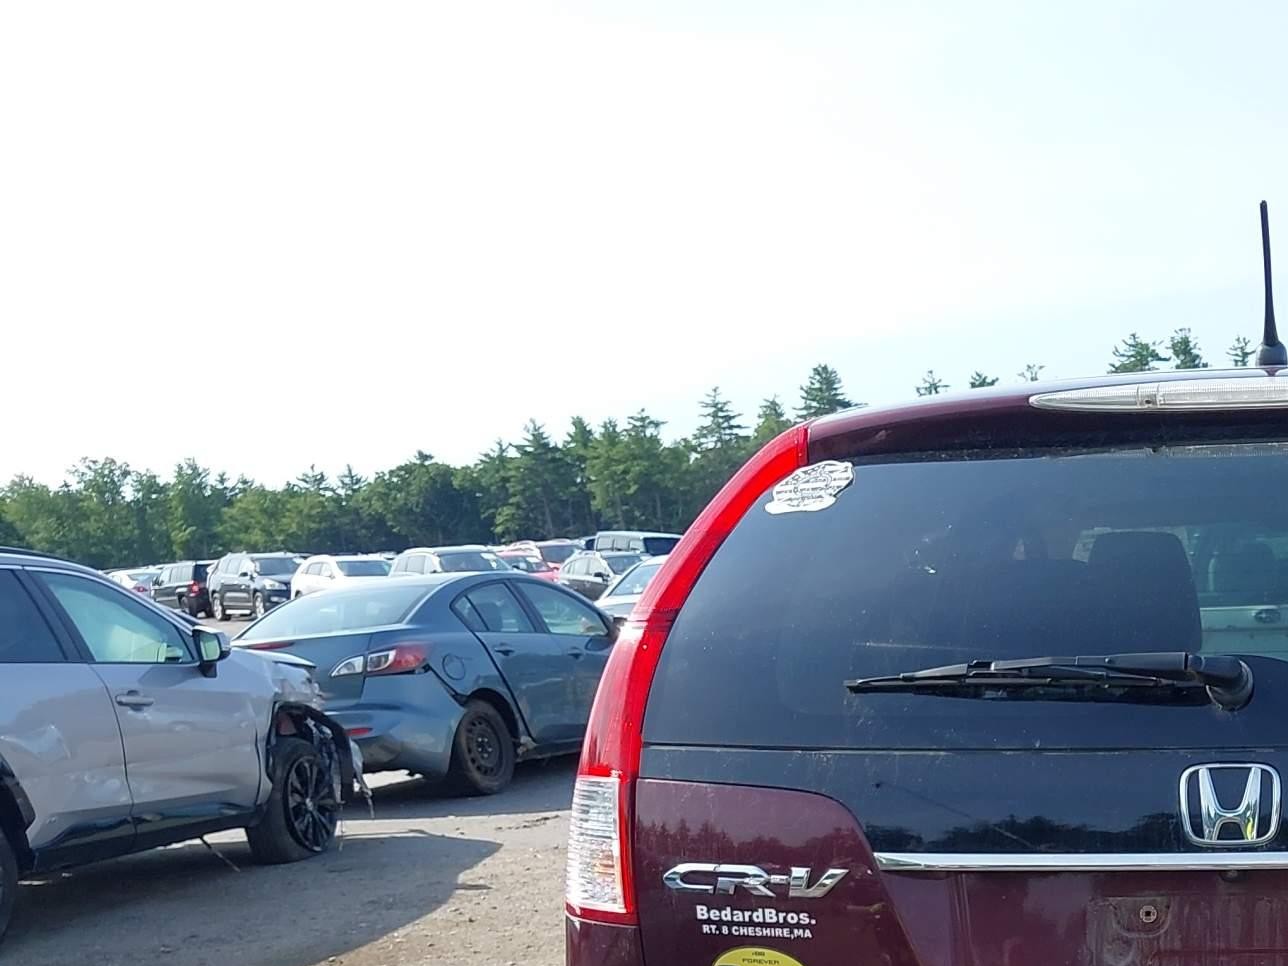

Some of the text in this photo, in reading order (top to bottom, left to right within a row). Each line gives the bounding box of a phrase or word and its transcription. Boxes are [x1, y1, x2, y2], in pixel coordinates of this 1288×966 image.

[662, 862, 850, 898] CR-V
[695, 905, 817, 925] BedardBros.
[702, 924, 812, 940] RT. 8 CHESHIRE,MA
